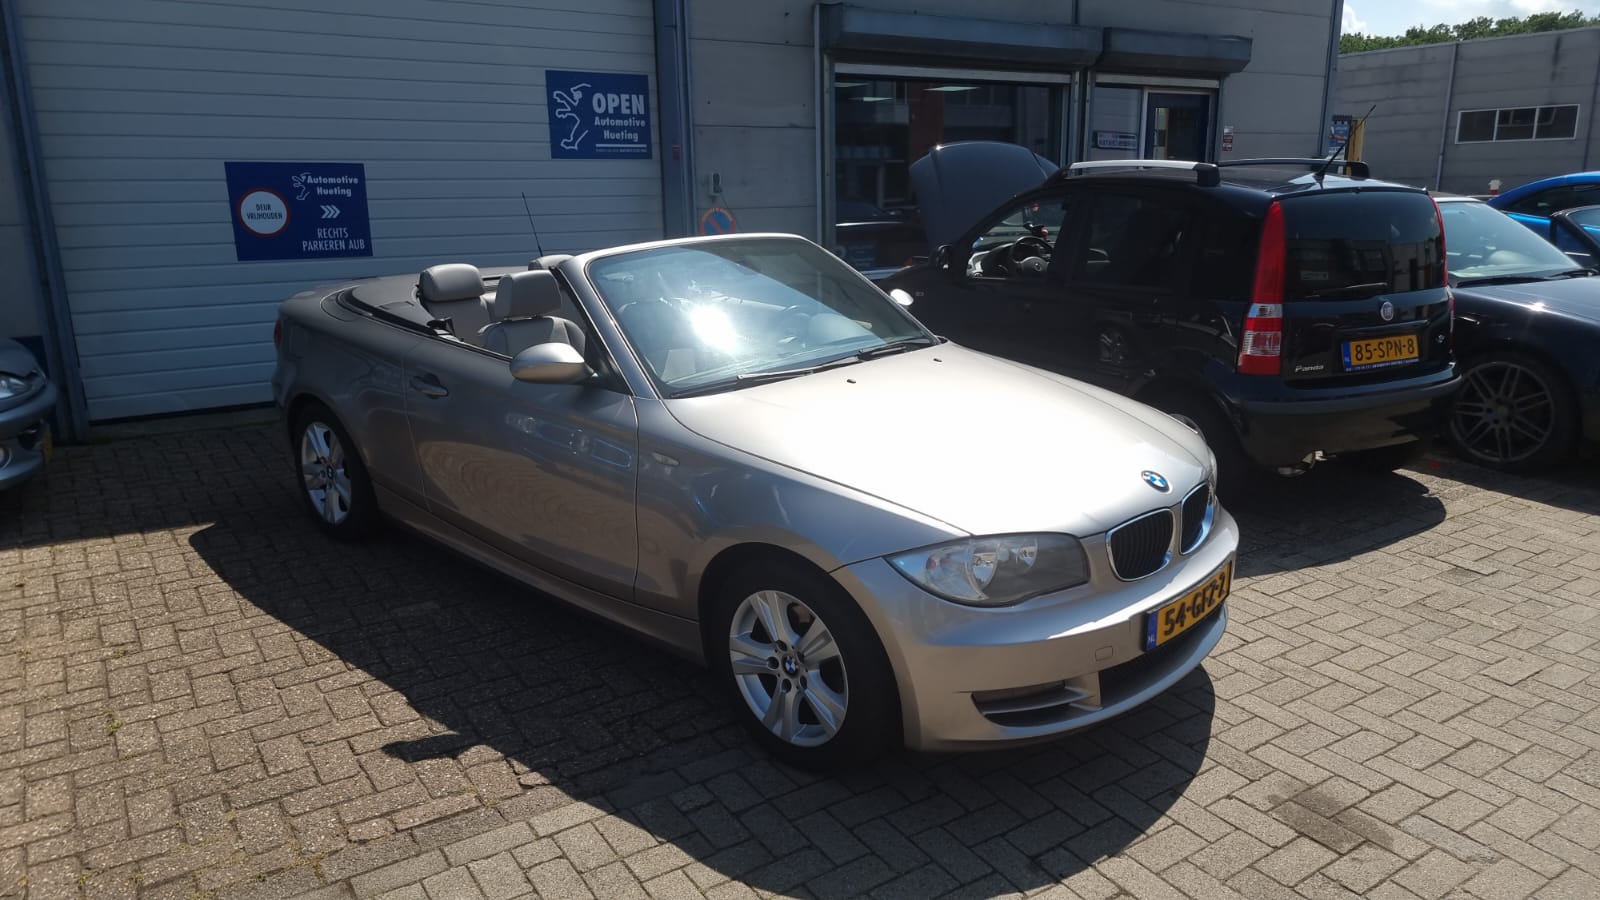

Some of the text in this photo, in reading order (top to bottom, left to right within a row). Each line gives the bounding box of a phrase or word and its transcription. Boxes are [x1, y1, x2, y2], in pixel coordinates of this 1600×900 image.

[592, 93, 645, 115] OPEN
[594, 116, 646, 127] Automotive
[603, 130, 639, 142] Hueting
[307, 175, 359, 185] Automotive
[317, 186, 352, 198] Hueting
[255, 203, 272, 211] DEUR
[317, 227, 349, 239] RECHTS
[302, 239, 365, 251] PARKEREN AUB
[1355, 338, 1415, 361] 85-SPN-8
